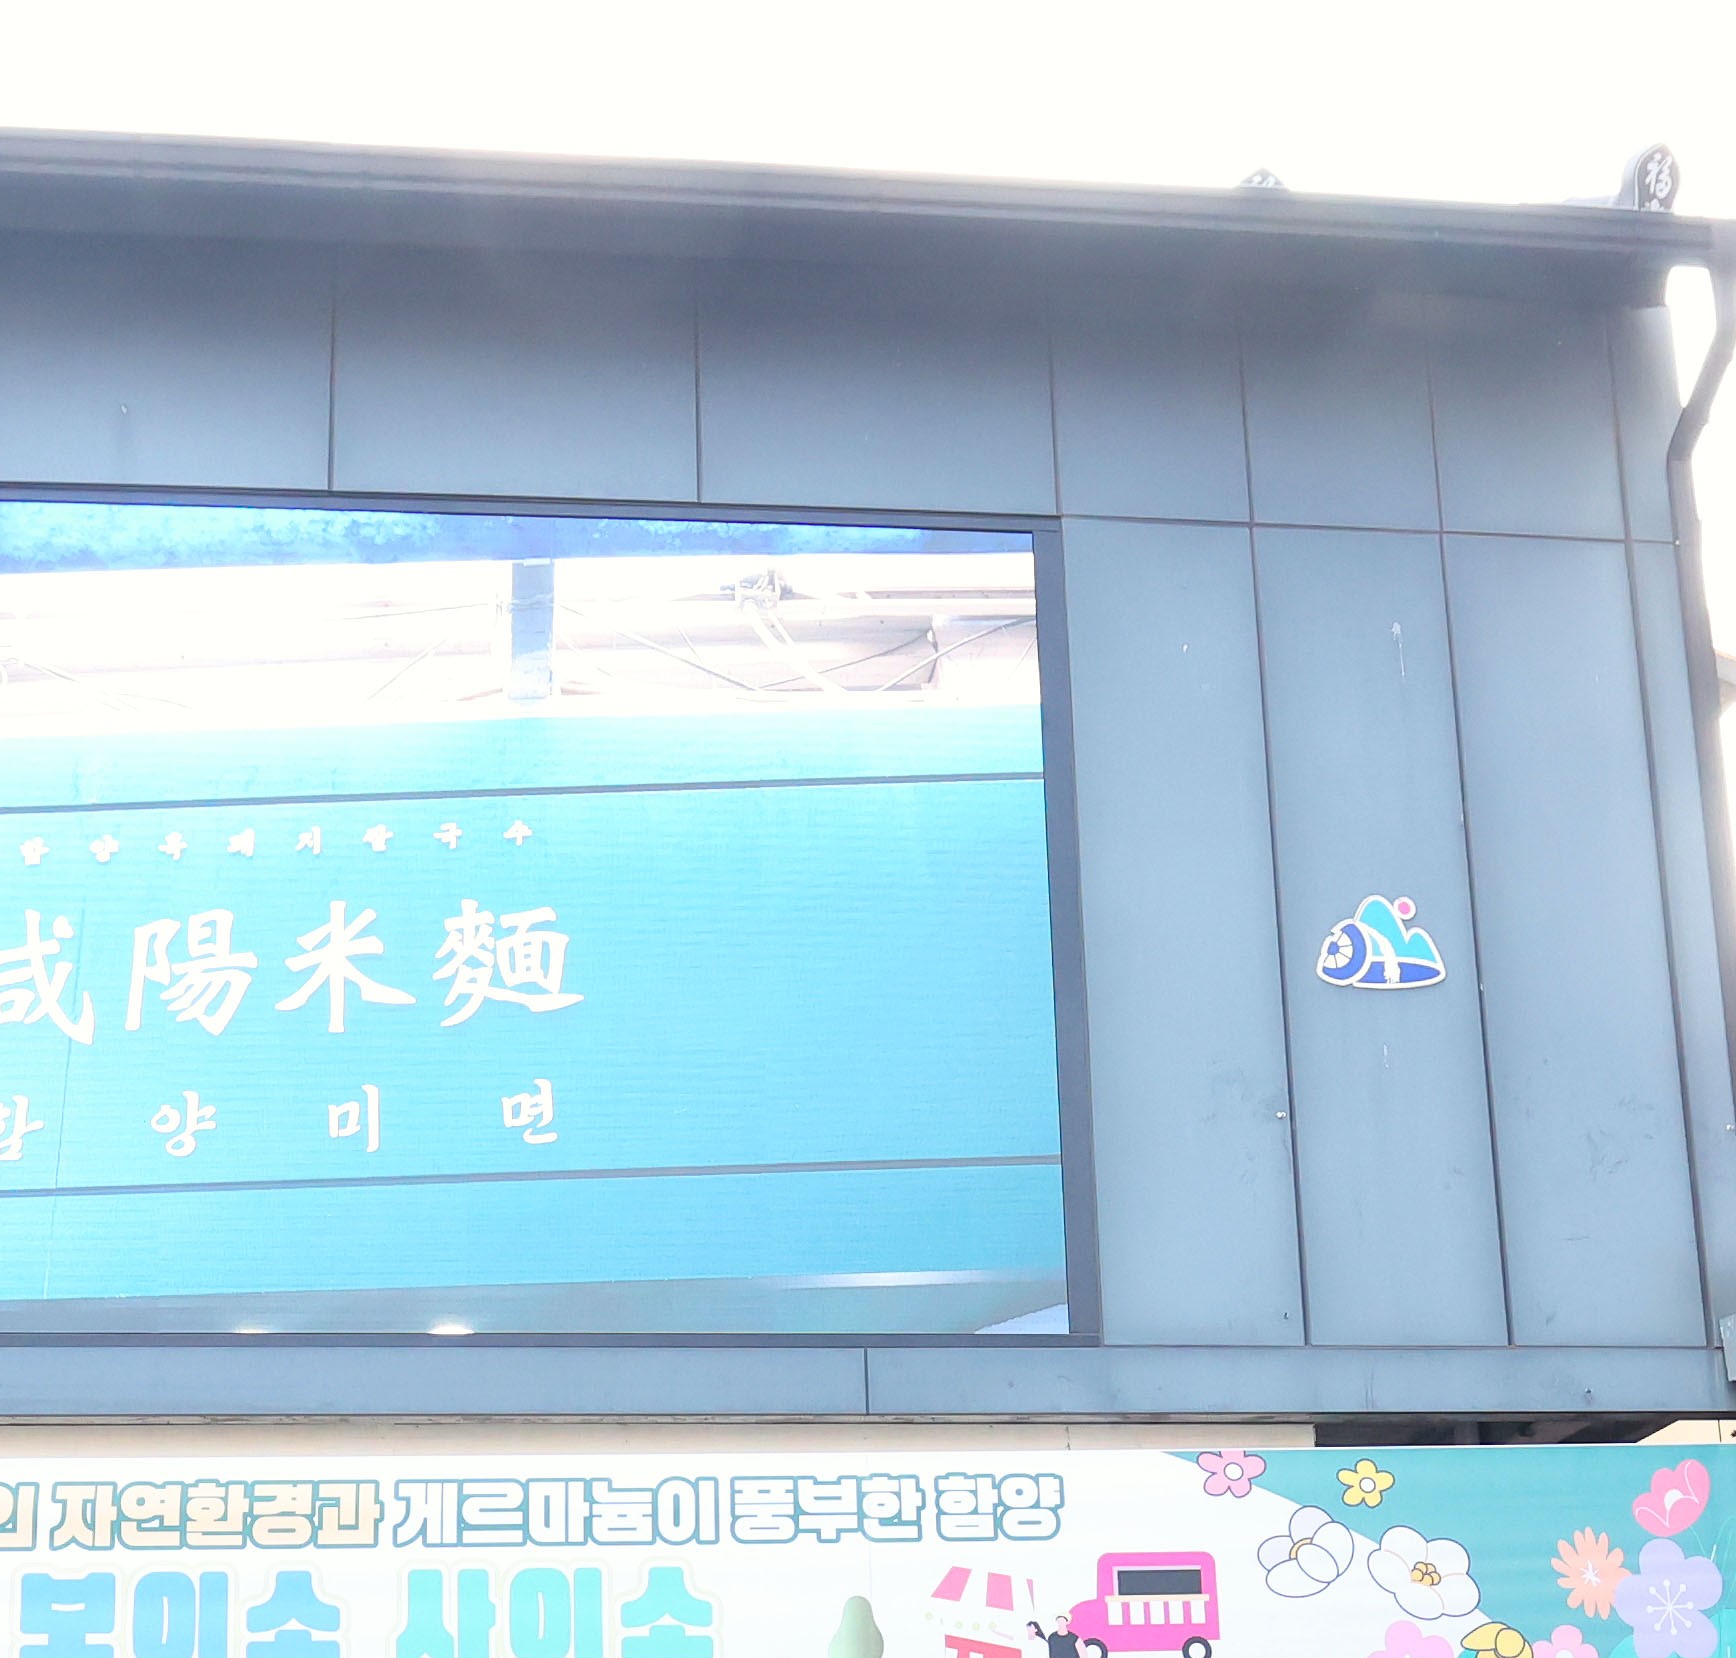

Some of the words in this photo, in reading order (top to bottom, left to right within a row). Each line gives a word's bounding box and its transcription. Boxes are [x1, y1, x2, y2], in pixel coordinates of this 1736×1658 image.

[48, 1477, 381, 1550] 자연환경과
[391, 1475, 721, 1549] 게르마늄이
[728, 1474, 927, 1547] 풍부한
[932, 1472, 1064, 1545] 함양
